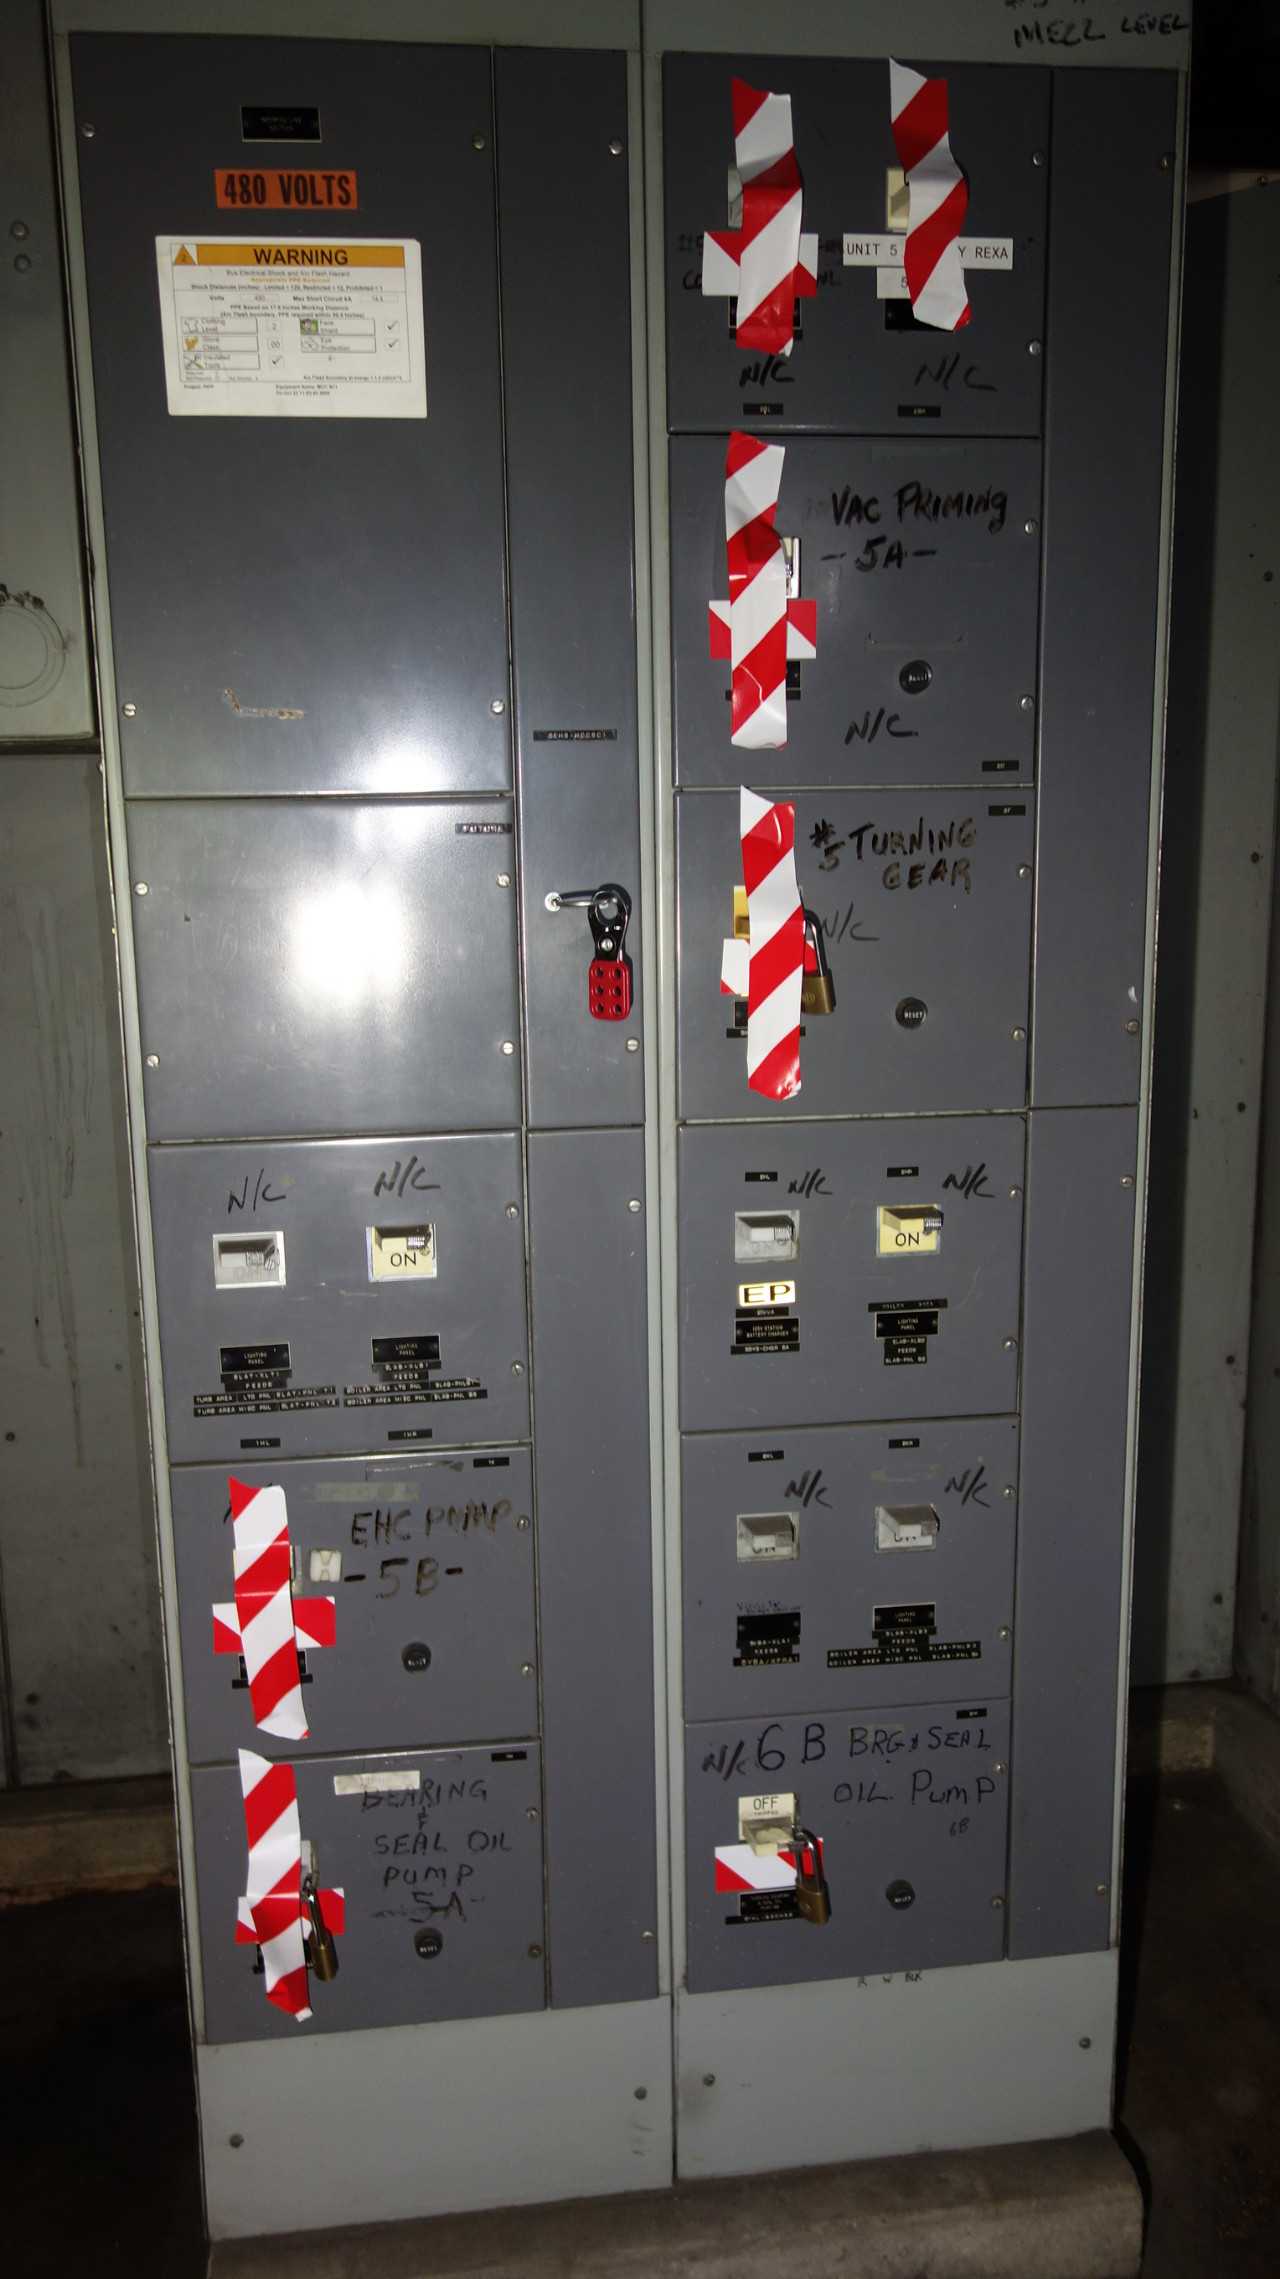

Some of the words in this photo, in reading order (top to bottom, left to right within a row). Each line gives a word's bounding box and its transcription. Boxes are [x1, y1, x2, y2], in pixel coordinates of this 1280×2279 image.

[1121, 13, 1190, 36] LEVEL
[224, 173, 267, 205] 480
[278, 174, 351, 206] VOLTS
[254, 248, 349, 266] WARNING
[846, 243, 881, 257] UNIT
[889, 244, 898, 257] 5
[975, 246, 1009, 259] REXA
[738, 355, 795, 388] N/C
[914, 353, 999, 392] N/C
[831, 486, 881, 526] VAC
[844, 708, 919, 744] N/C
[849, 816, 977, 860] TURNING
[882, 858, 972, 895] GEAR
[904, 1010, 924, 1019] RESET
[373, 1156, 441, 1197] N/C
[787, 1168, 833, 1199] N/C
[942, 1163, 995, 1199] N/C
[227, 1168, 287, 1215] N/C
[895, 1231, 920, 1247] ON
[390, 1252, 418, 1267] ON
[743, 1284, 791, 1304] EP
[346, 1385, 372, 1394] BOILER
[374, 1385, 391, 1393] AREA
[346, 1397, 372, 1406] BOILER
[375, 1396, 392, 1404] AREA
[219, 1406, 236, 1414] AREA
[785, 1469, 832, 1508] N/C
[944, 1465, 991, 1508] N/C
[351, 1508, 413, 1549] EHC
[425, 1499, 512, 1536] PUMP
[829, 1658, 858, 1667] BOILER
[830, 1649, 859, 1658] BOILER
[863, 1648, 882, 1656] AREA
[702, 1740, 746, 1781] N/C
[927, 1726, 991, 1750] SEAL
[753, 1796, 779, 1810] OFF
[833, 1782, 888, 1803] OIL
[375, 1832, 448, 1856] SEAL
[467, 1830, 513, 1853] OIL
[384, 1863, 474, 1888] PUMP
